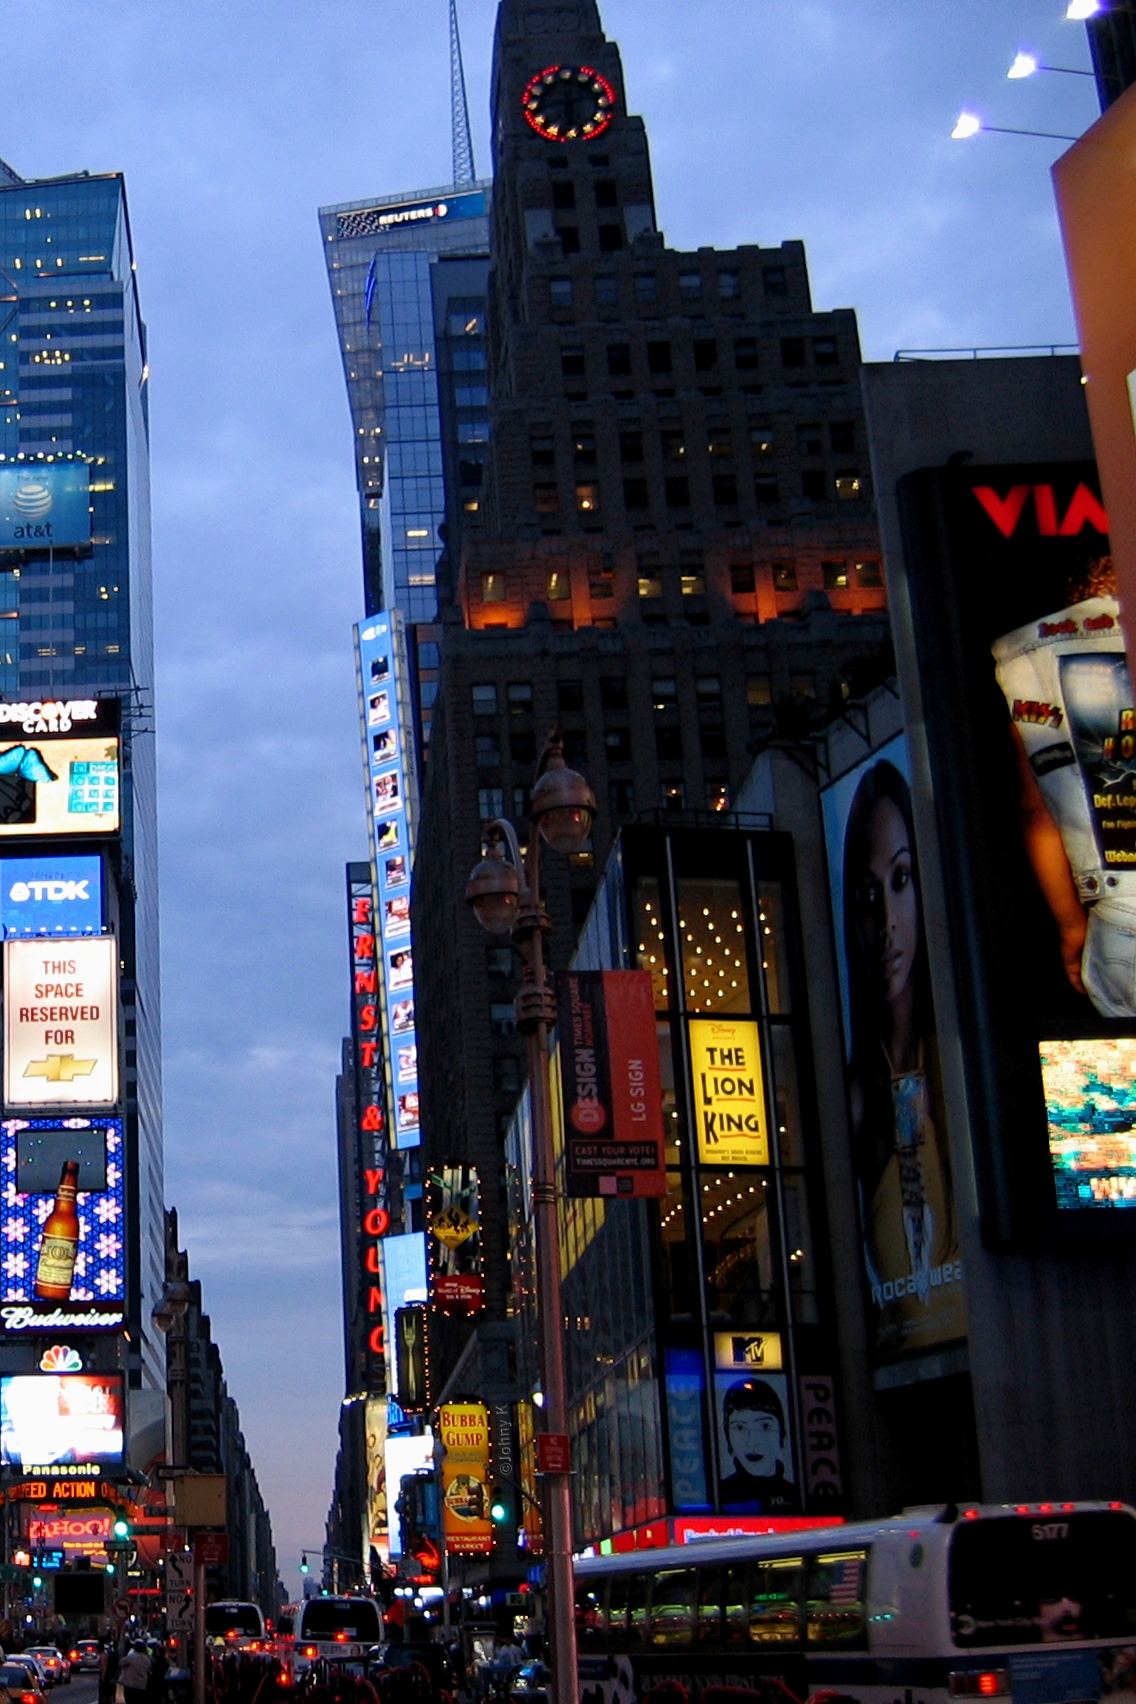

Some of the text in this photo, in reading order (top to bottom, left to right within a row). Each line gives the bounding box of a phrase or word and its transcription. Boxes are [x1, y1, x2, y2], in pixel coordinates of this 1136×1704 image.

[378, 206, 435, 226] REUTERS
[13, 521, 53, 541] at&t
[1012, 699, 1064, 730] KISS
[22, 719, 73, 734] CARD
[27, 880, 90, 901] TDK
[42, 959, 77, 975] THIS
[34, 982, 84, 999] SPACE
[354, 897, 380, 1068] ERNST
[19, 1005, 100, 1023] RESERVED
[44, 1029, 75, 1046] FOR
[705, 1047, 746, 1067] THE
[574, 1048, 601, 1123] DESIGN
[627, 1059, 647, 1122] LG SIGN
[360, 1104, 384, 1131] &
[575, 1145, 598, 1155] CAST
[601, 1145, 626, 1155] YOUR
[1, 1305, 124, 1330] Budweiser
[442, 1411, 486, 1428] BUBBA
[446, 1430, 483, 1446] GUMP
[22, 1463, 101, 1476] Panasonic
[52, 1481, 96, 1498] ACTION
[29, 1517, 110, 1540] YAHOO!
